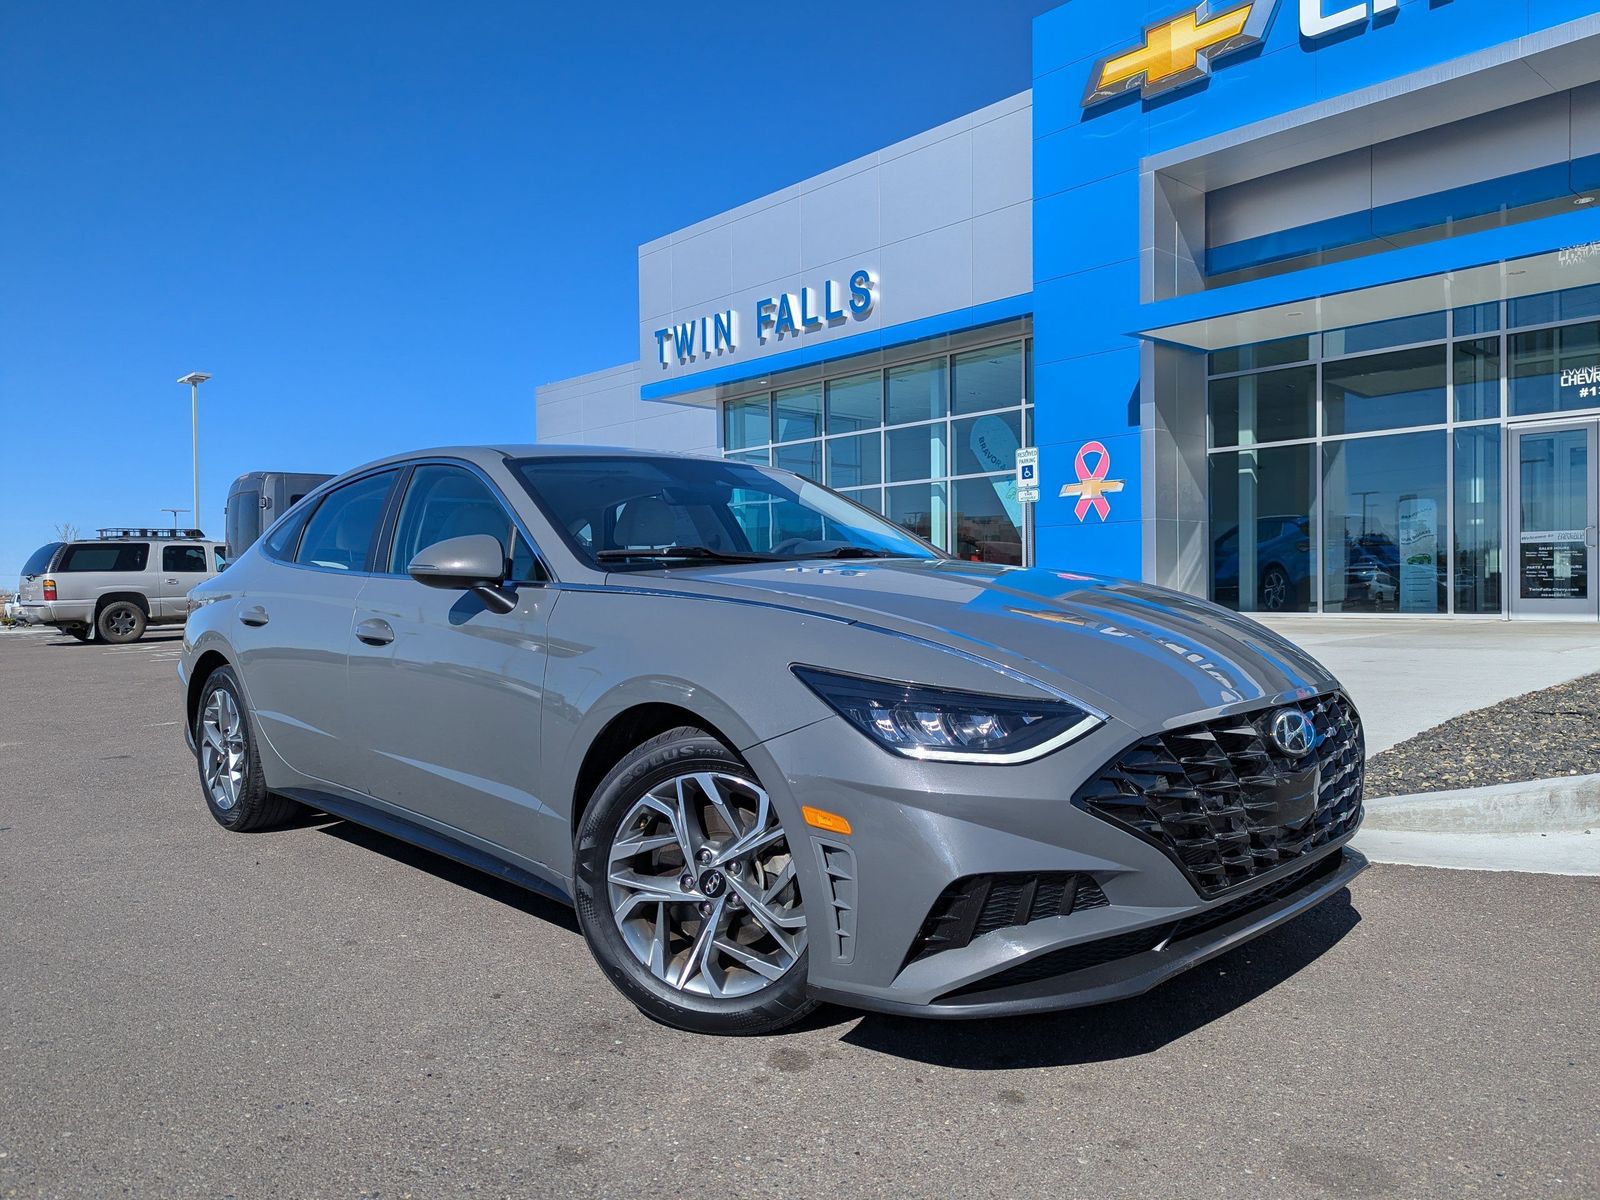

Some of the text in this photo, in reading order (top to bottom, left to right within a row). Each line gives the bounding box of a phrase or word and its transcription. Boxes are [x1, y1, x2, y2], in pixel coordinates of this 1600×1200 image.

[655, 269, 875, 364] TWIN FALLS
[1579, 386, 1600, 398] #1
[620, 745, 695, 787] SOLUS
